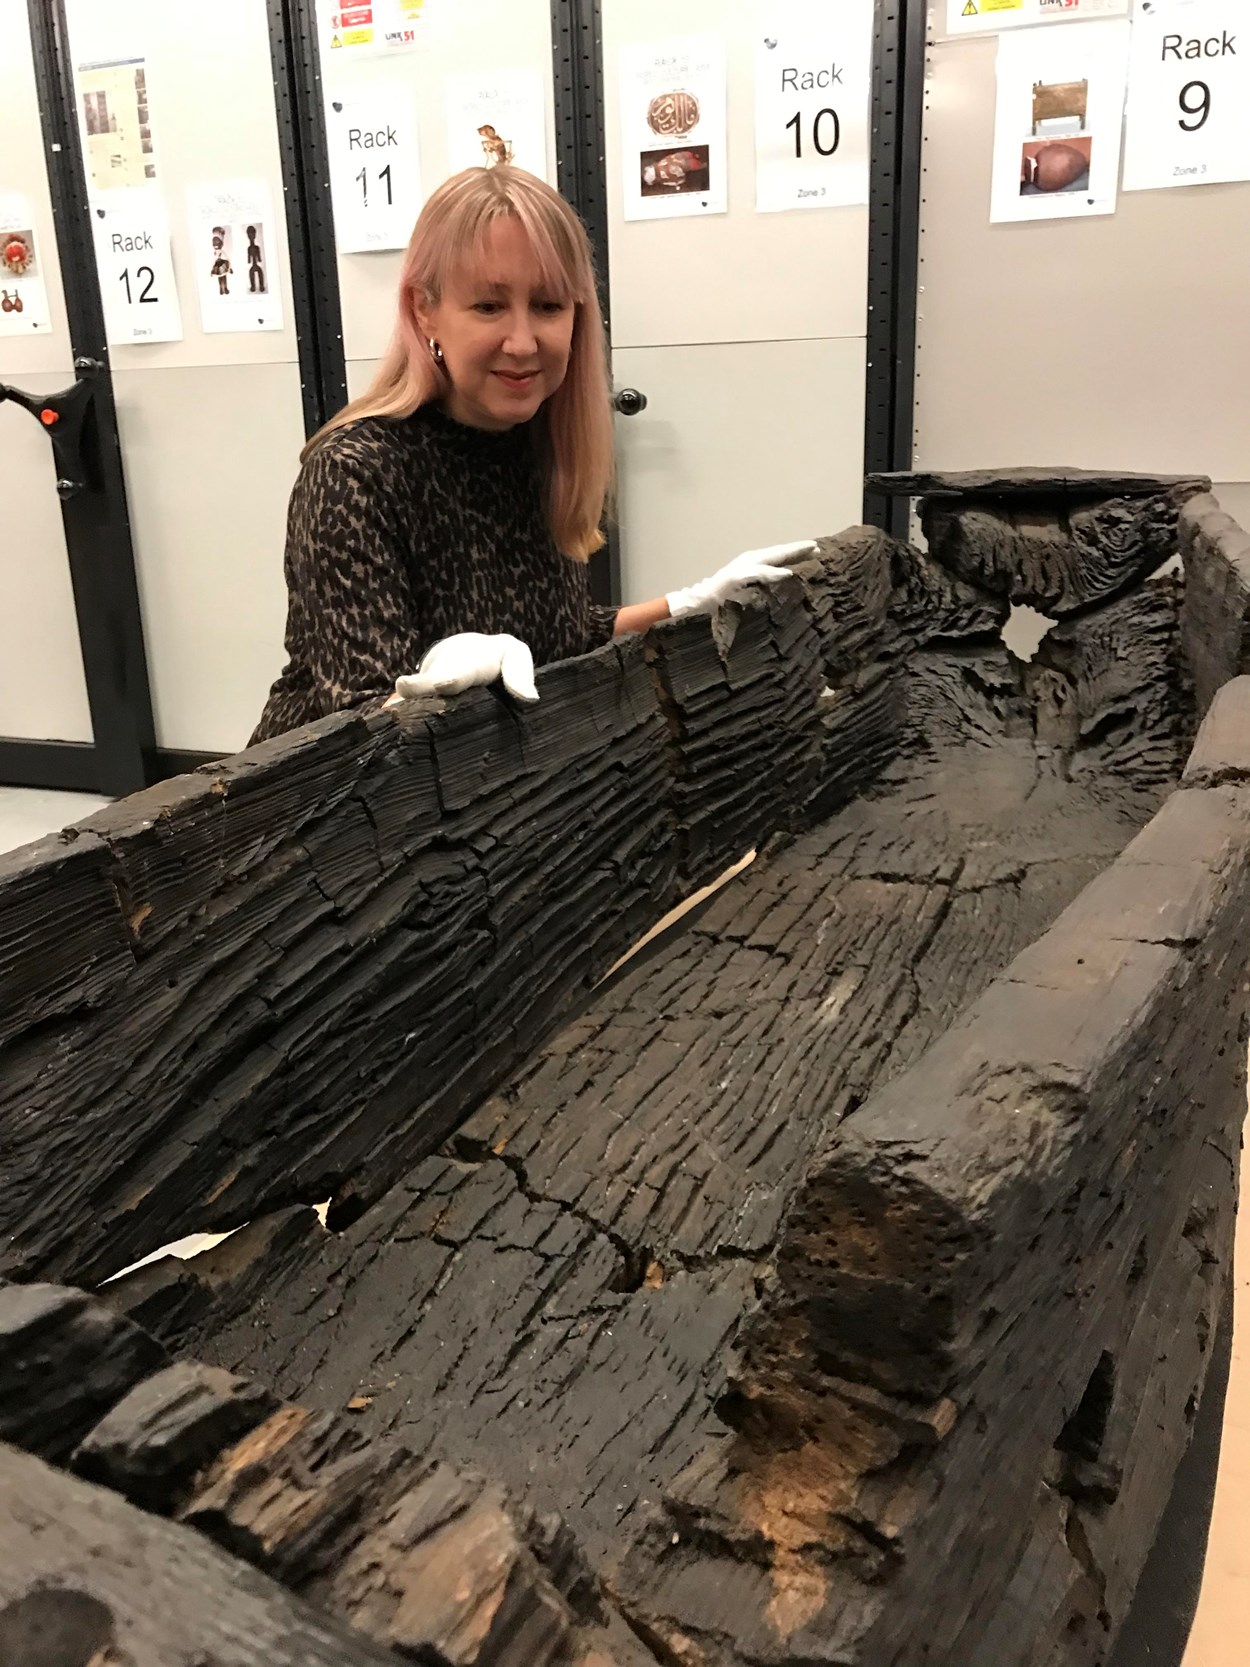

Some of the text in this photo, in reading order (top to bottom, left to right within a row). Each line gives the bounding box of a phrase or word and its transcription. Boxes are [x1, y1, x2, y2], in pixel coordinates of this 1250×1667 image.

[404, 30, 415, 41] 51
[1161, 30, 1237, 61] Rack
[781, 62, 843, 92] Rack
[1178, 80, 1211, 132] 9
[349, 125, 398, 150] Rack
[785, 108, 840, 158] 10
[1172, 164, 1207, 176] Zone 3
[355, 164, 393, 207] 11
[797, 187, 827, 198] Zone 3
[112, 231, 154, 253] Rack
[118, 265, 159, 304] 12
